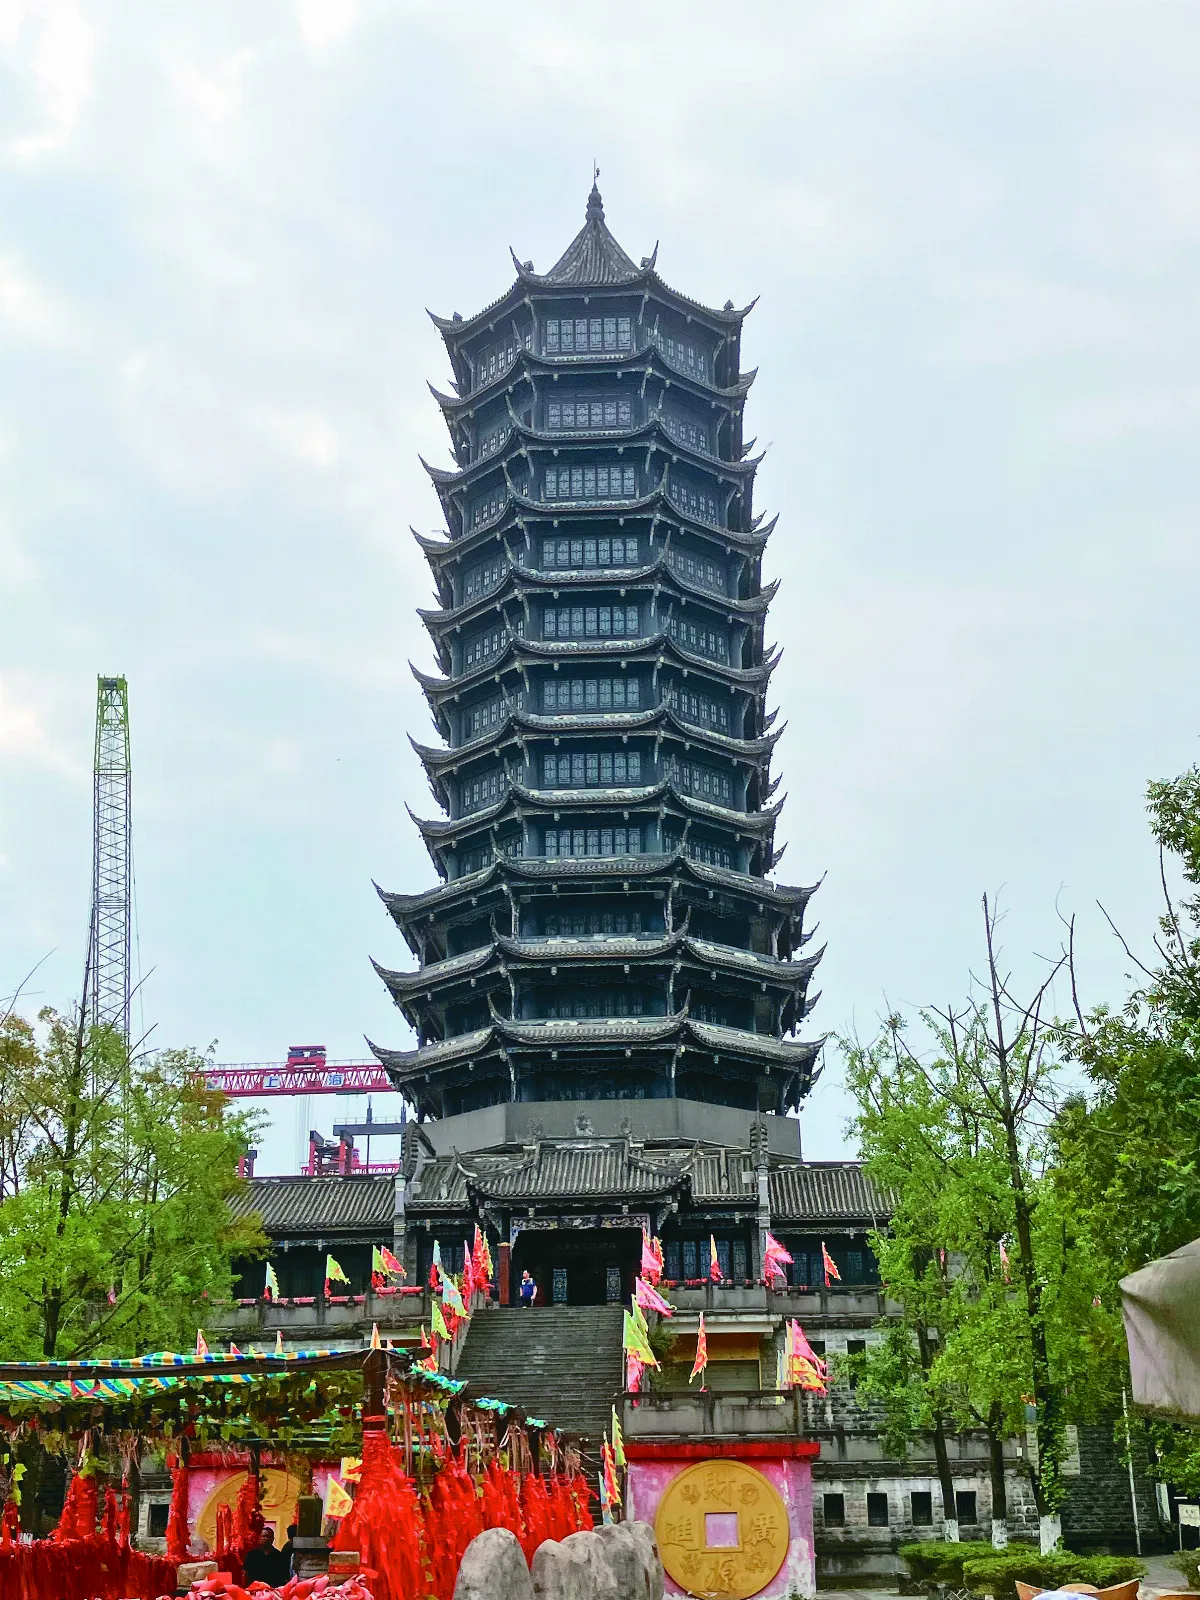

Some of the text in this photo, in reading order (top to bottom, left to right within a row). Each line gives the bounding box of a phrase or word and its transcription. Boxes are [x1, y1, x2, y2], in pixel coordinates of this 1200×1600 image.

[703, 1472, 736, 1506] 財
[663, 1516, 700, 1551] 進
[743, 1513, 779, 1548] 廣
